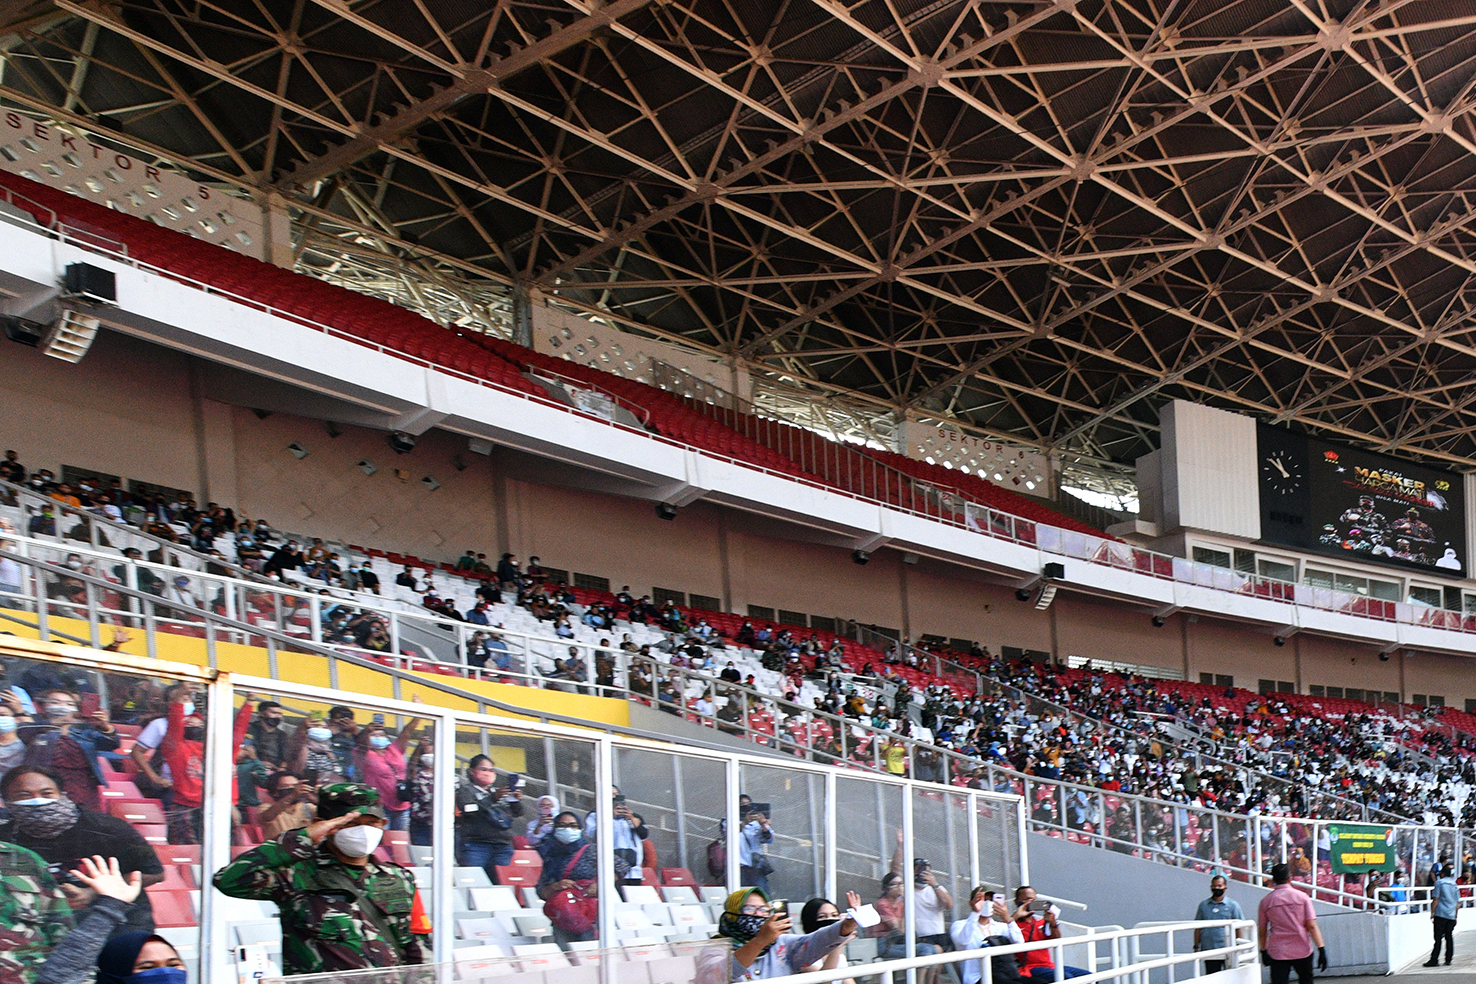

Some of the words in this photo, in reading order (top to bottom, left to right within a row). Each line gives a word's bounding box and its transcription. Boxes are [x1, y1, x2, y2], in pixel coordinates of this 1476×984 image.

[6, 112, 162, 183] SEKTOR
[198, 185, 210, 200] 5
[938, 429, 1003, 453] SEKTOR
[1354, 466, 1426, 491] MASKER
